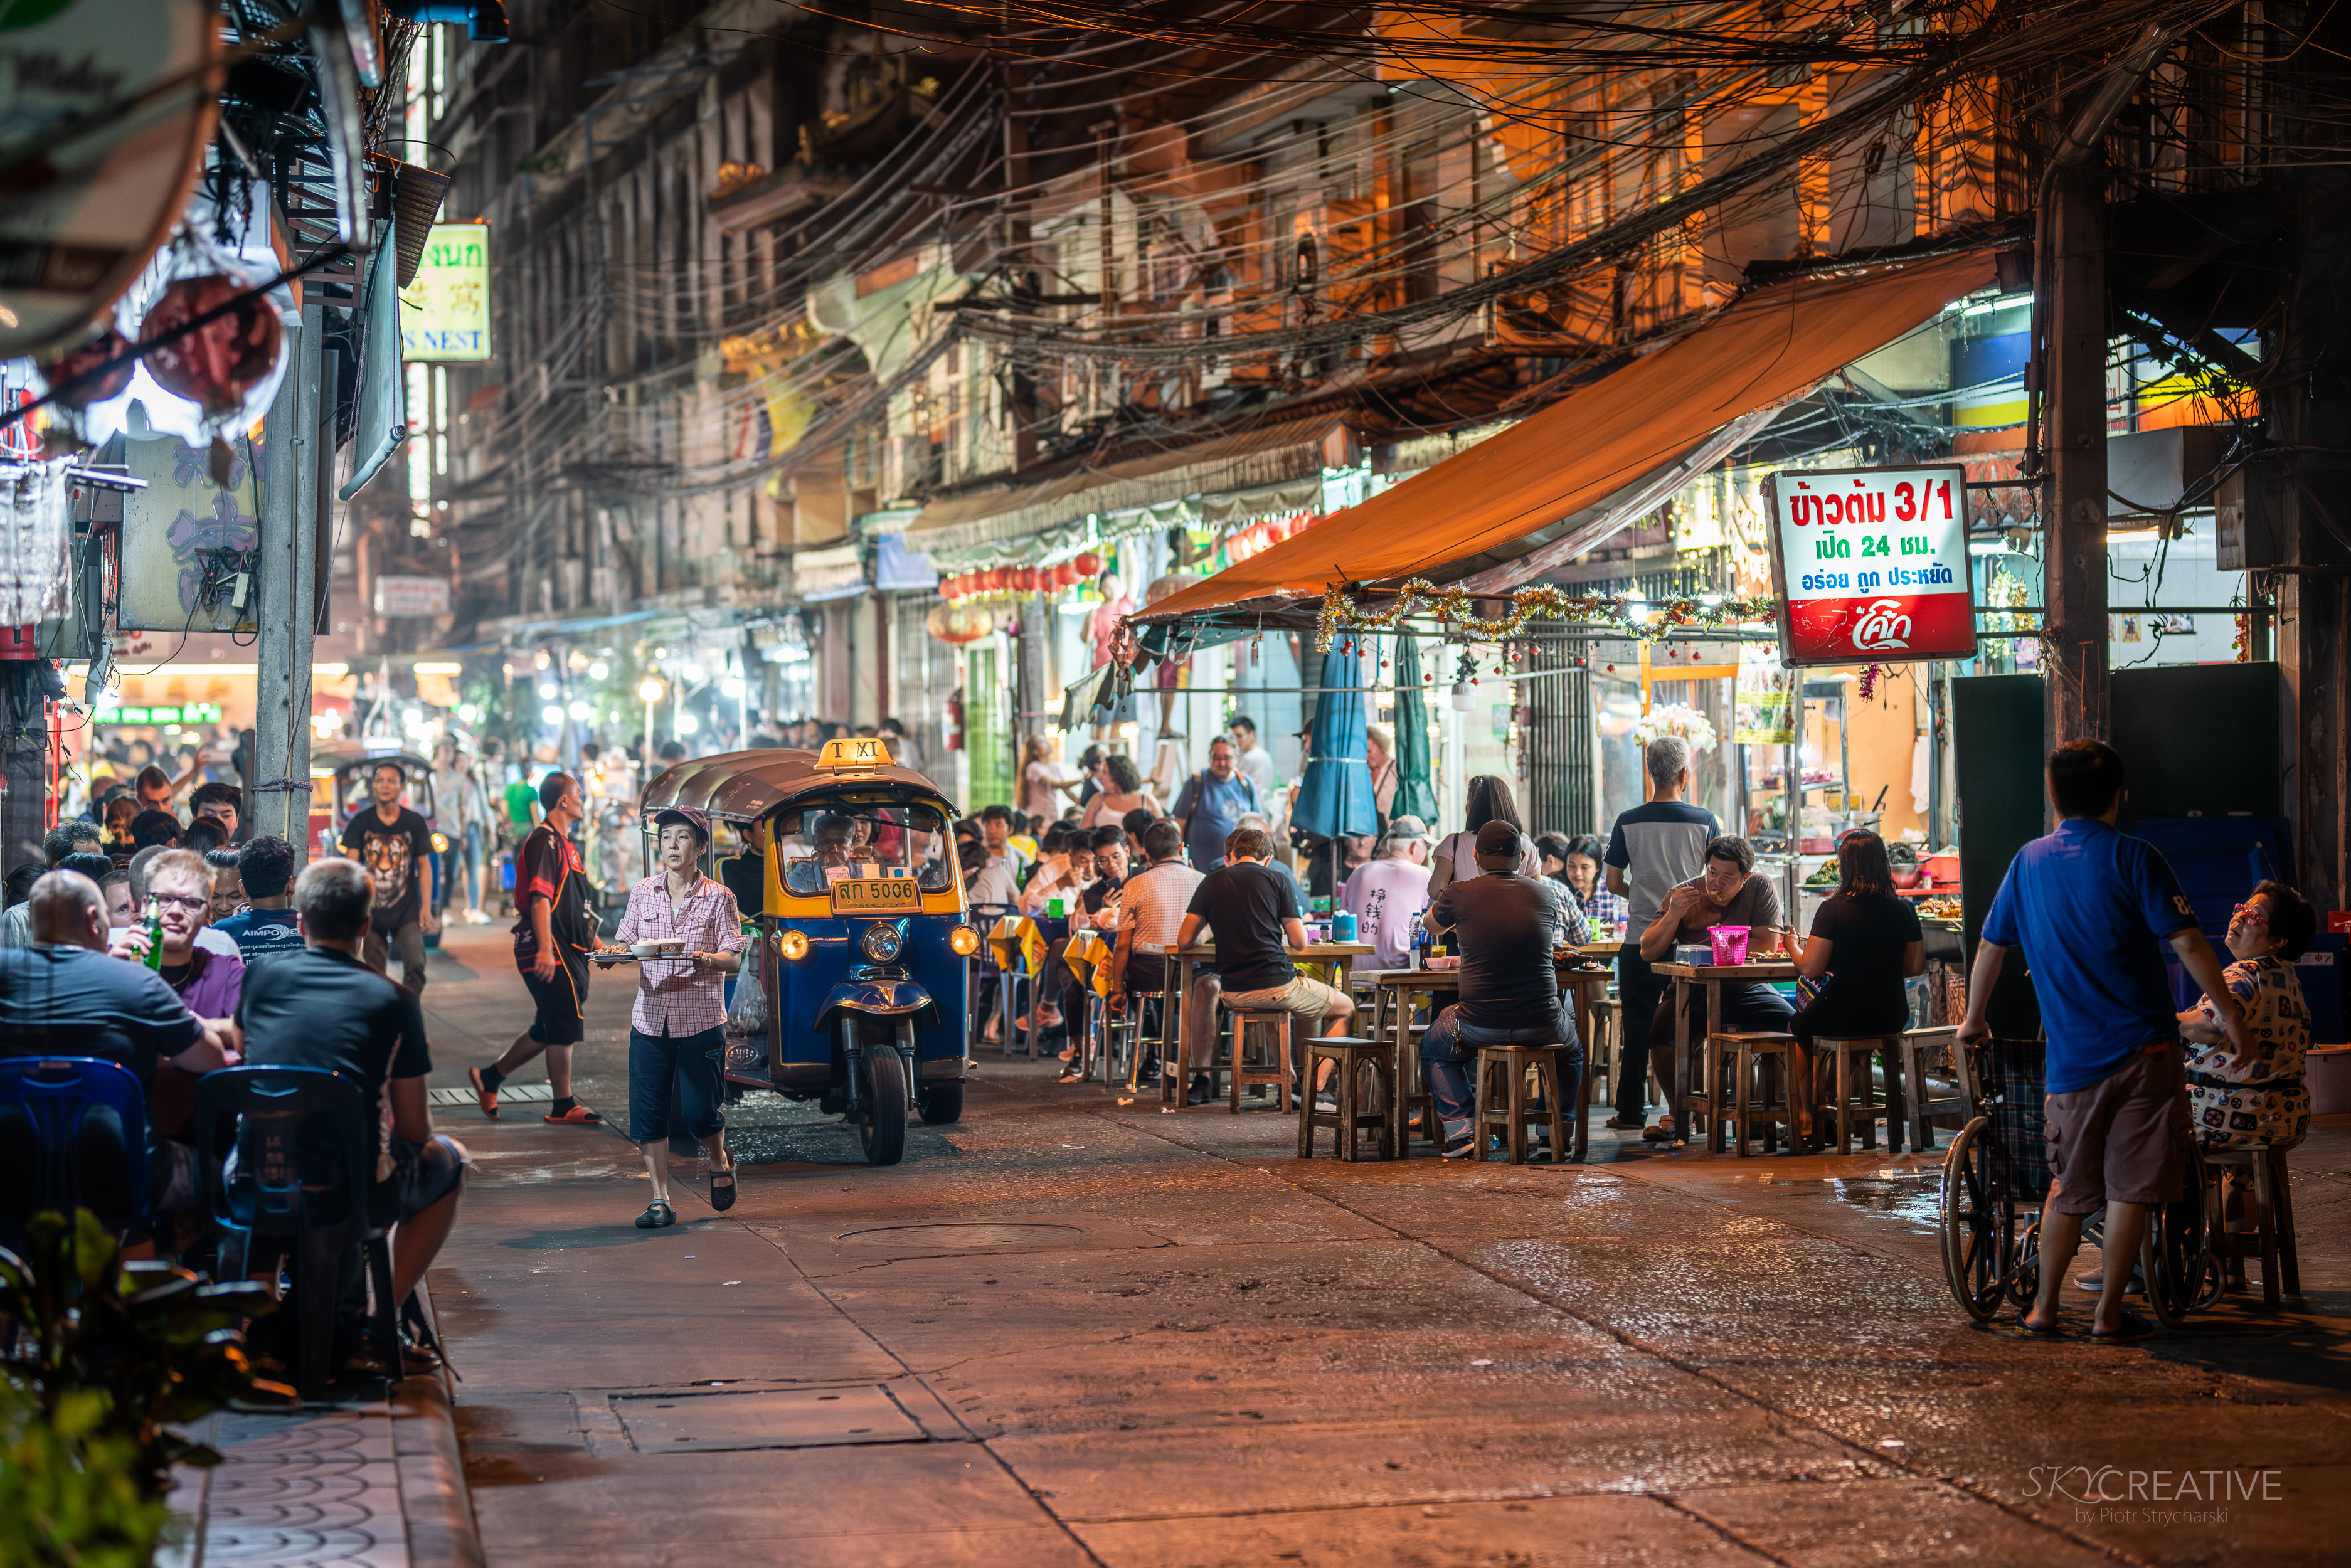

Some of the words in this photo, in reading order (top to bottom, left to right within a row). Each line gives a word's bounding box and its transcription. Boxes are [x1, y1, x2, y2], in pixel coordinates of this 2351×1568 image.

[421, 243, 482, 266] งนก
[423, 329, 483, 351] NEST
[1790, 479, 1886, 526] ข้าวต้ม
[1894, 479, 1953, 522] 3/1
[1815, 530, 1851, 559] เปิด
[1861, 535, 1891, 557] 24
[1900, 536, 1936, 556] ชม.
[1802, 569, 1849, 590] อร่อย
[1857, 571, 1881, 594] ถูก
[1888, 562, 1953, 586] ประหยัด
[1852, 599, 1912, 650] โค้ก
[831, 741, 878, 758] TXI
[839, 883, 864, 899] สก
[870, 882, 913, 899] 5006
[2172, 894, 2195, 915] 8
